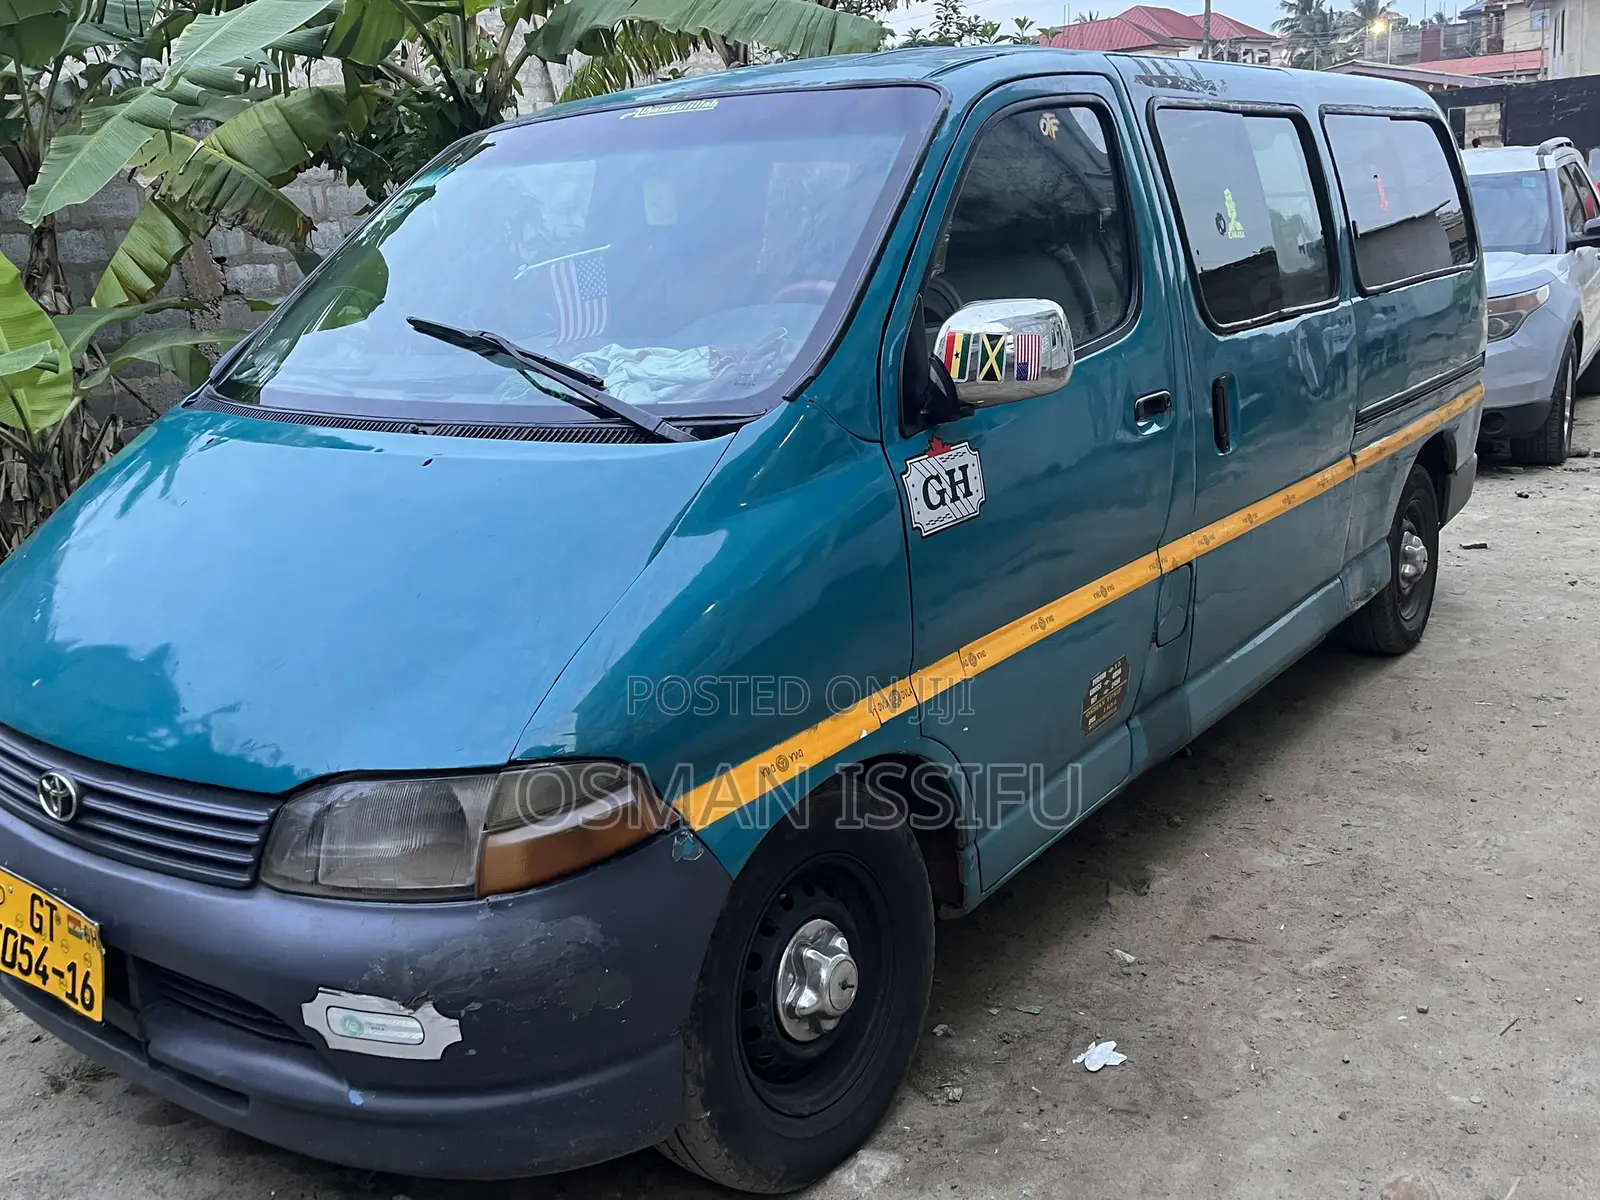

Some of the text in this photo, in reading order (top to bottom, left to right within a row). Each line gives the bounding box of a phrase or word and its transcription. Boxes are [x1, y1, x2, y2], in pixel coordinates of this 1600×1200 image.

[922, 463, 974, 511] GH
[901, 687, 913, 699] DVLA
[788, 749, 804, 762] DVLA
[30, 892, 99, 949] GT GH
[0, 923, 95, 1012] 054-16
